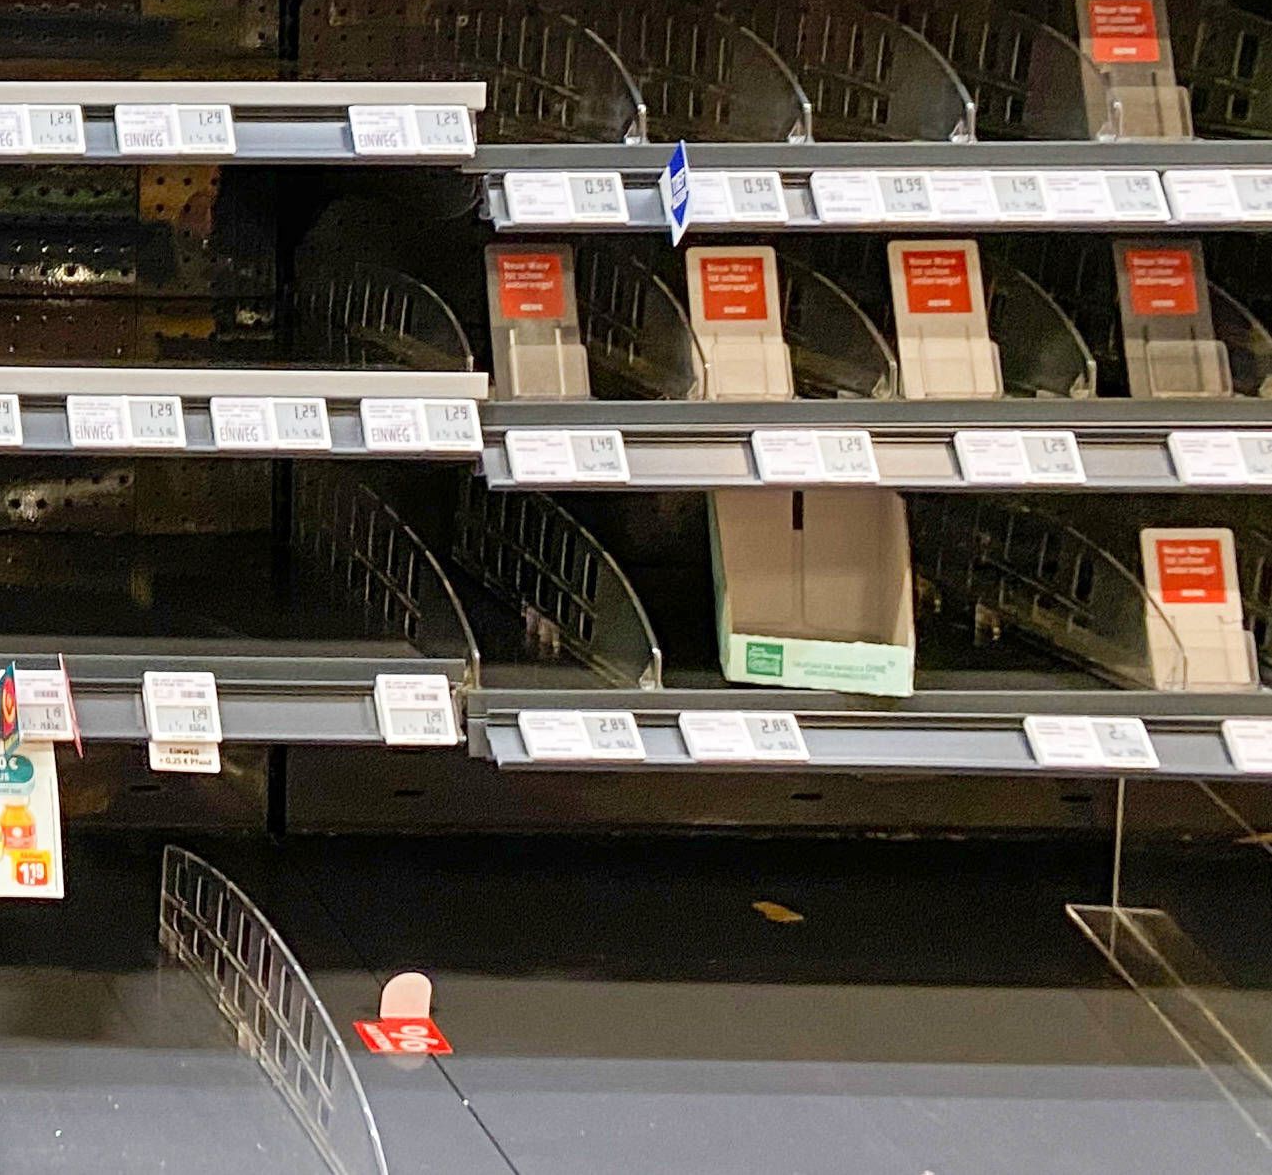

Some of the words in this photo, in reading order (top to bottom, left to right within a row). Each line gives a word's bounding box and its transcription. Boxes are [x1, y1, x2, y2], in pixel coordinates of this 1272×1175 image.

[359, 132, 397, 148] EINWEG
[75, 425, 113, 440] EINWEG
[372, 427, 410, 442] EINWEG
